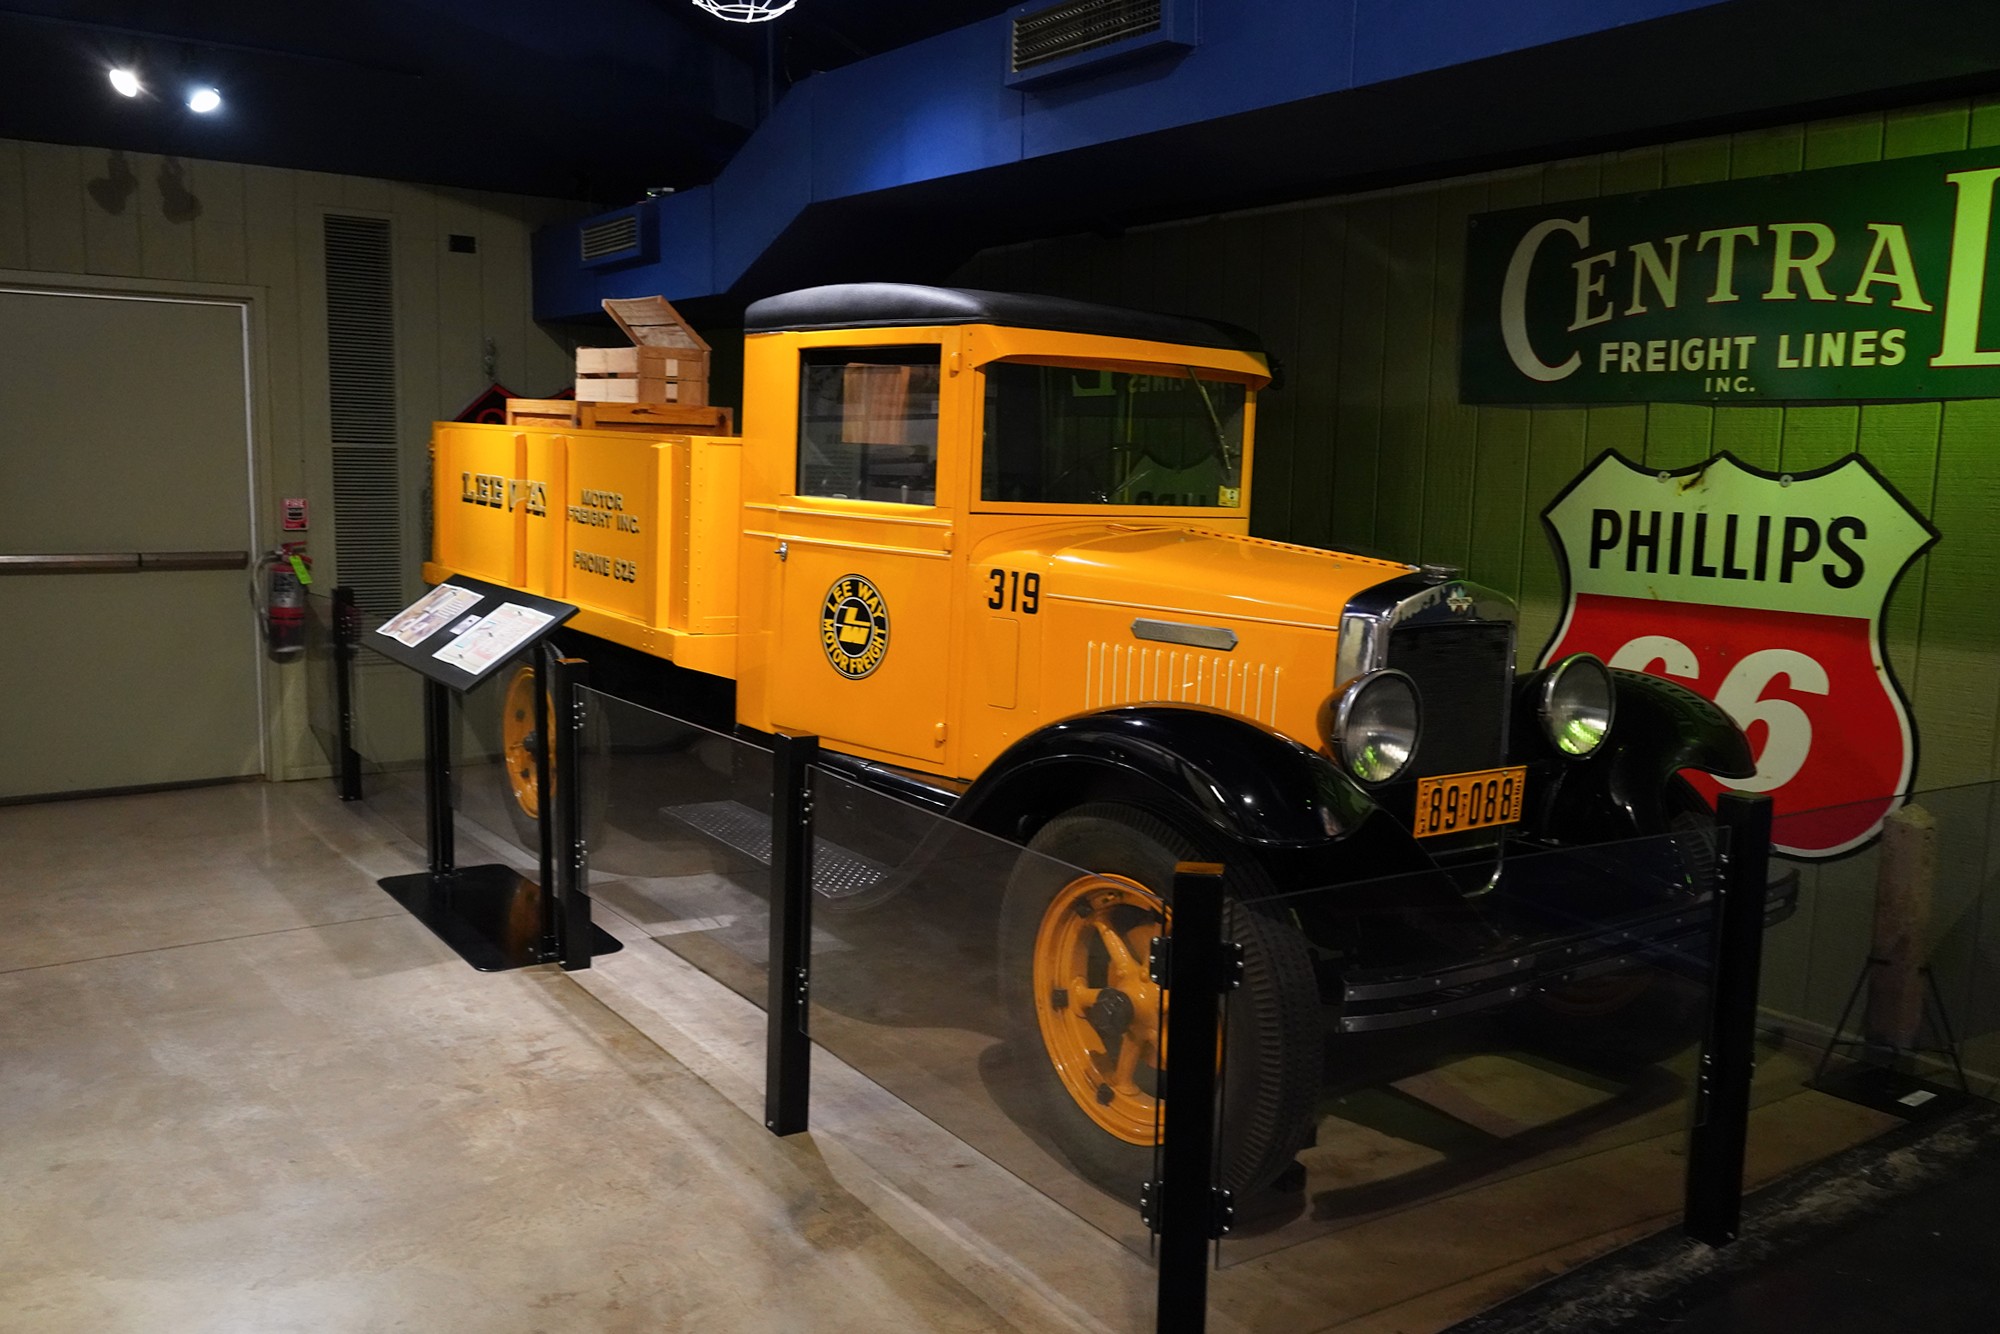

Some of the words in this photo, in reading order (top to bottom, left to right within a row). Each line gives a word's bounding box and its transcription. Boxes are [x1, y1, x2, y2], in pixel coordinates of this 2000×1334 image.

[1501, 167, 2000, 382] CENTRAL
[1599, 335, 1757, 374] FREIGHT
[1777, 328, 1907, 370] LINES
[1705, 376, 1756, 394] INC.
[462, 471, 503, 509] LEE
[582, 488, 623, 511] MOTOR
[567, 505, 612, 529] FREIGHT
[573, 549, 610, 577] PHONE
[1588, 507, 1868, 590] PHILLIPS
[827, 580, 853, 613] LEE
[858, 581, 885, 618] WAY
[988, 568, 1040, 615] 319
[823, 618, 849, 671] MOTOR
[849, 625, 887, 674] FREIGHT
